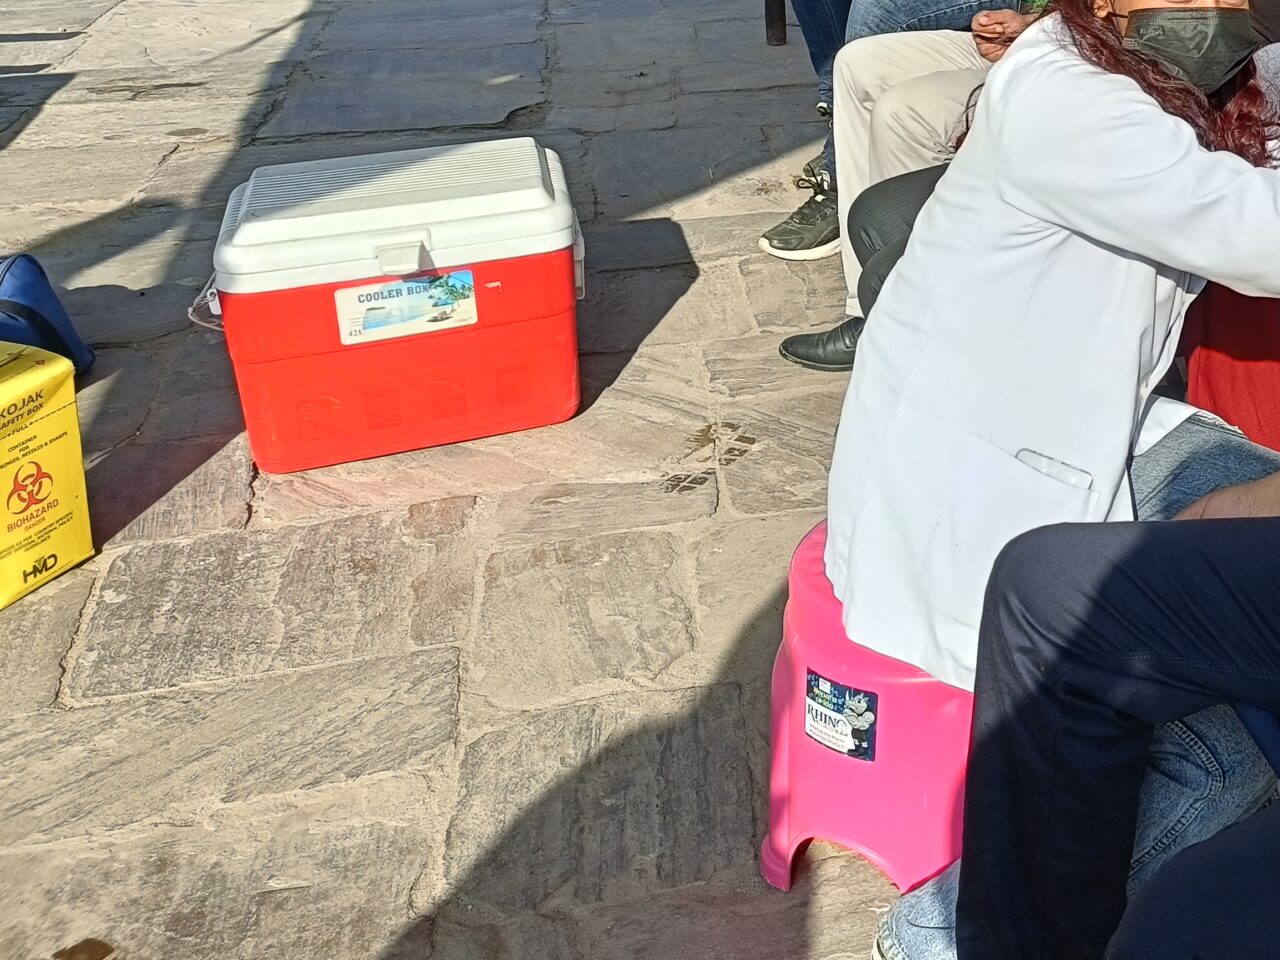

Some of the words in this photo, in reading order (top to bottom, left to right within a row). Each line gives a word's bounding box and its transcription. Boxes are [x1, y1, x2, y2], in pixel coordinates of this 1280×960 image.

[357, 287, 403, 304] COOLER
[406, 284, 430, 296] BOX
[0, 411, 26, 430] AFETY
[26, 401, 44, 416] BOX
[12, 424, 29, 435] FULL
[7, 434, 38, 453] CONTAINER
[7, 498, 59, 533] BIOHAZARD
[24, 516, 46, 532] DANGER
[22, 553, 58, 584] HMD
[807, 703, 848, 731] RHINO
